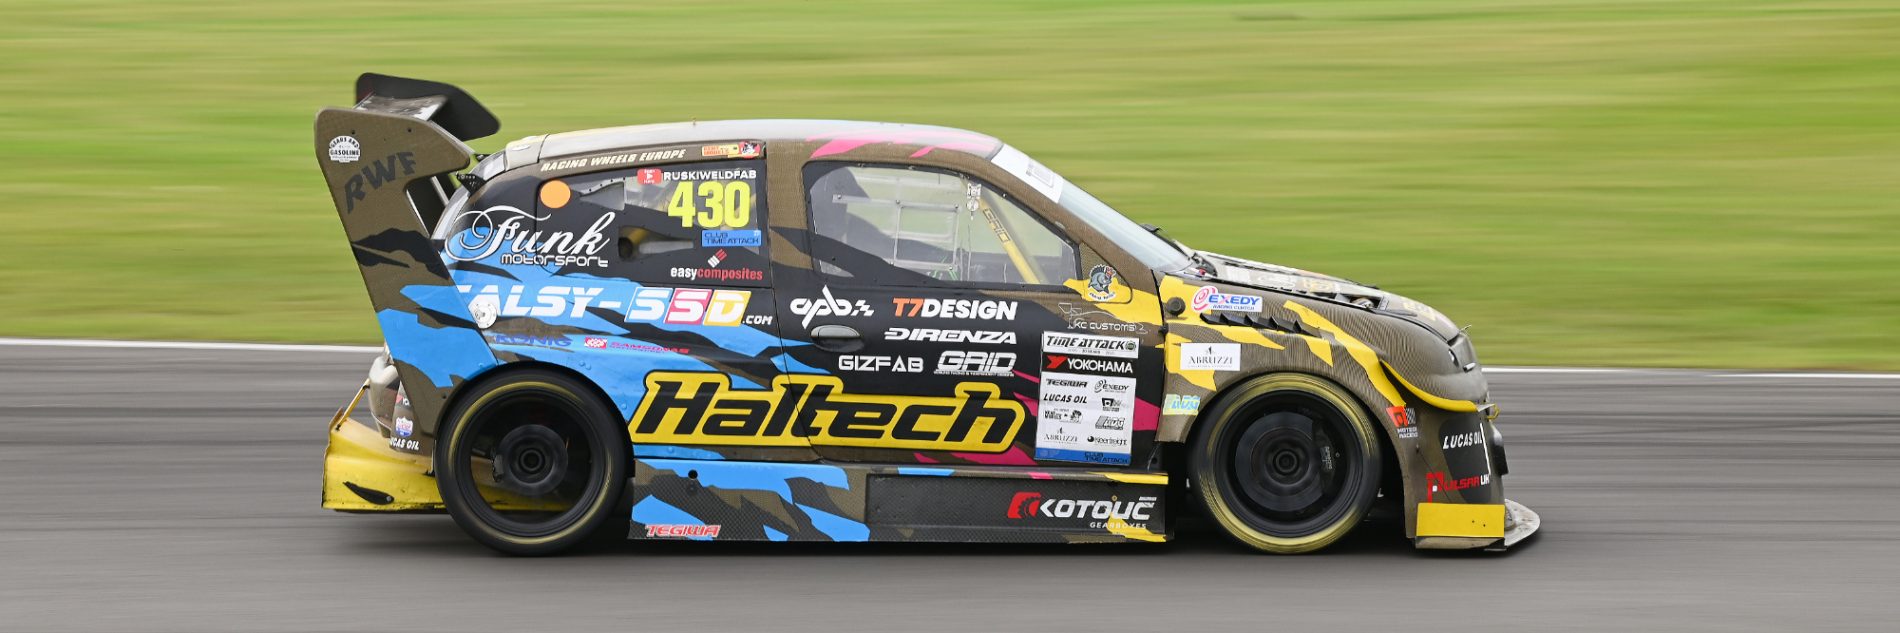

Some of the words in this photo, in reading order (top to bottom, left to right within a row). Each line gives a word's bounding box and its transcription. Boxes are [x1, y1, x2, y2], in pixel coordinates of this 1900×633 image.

[540, 158, 588, 172] RACING
[590, 153, 638, 167] WHEELS
[639, 149, 687, 162] EUROPE
[344, 151, 417, 214] RWF
[664, 170, 757, 181] RUSKIWELDFAB
[668, 181, 751, 228] 430
[444, 205, 616, 261] Funk
[670, 266, 763, 281] easycomposites
[1208, 294, 1260, 306] EXEDY
[892, 298, 1018, 320] T7DESIGN
[1089, 322, 1136, 332] CUSTOMS
[884, 327, 1018, 344] DIRENZA
[838, 355, 924, 373] GIZFAB
[937, 350, 1017, 372] GRID
[1067, 357, 1133, 373] YOKOHAMA
[1189, 355, 1233, 364] ABRUZZI
[1046, 379, 1088, 388] TEGIWA
[1102, 383, 1130, 391] EXEDY
[1043, 393, 1072, 403] LUCAS
[1073, 396, 1088, 404] OIL
[634, 380, 1017, 444] Haltech
[406, 439, 419, 450] OIL
[1442, 432, 1473, 450] LUCAS
[1473, 431, 1483, 444] OIL
[646, 525, 720, 537] TEGIWA
